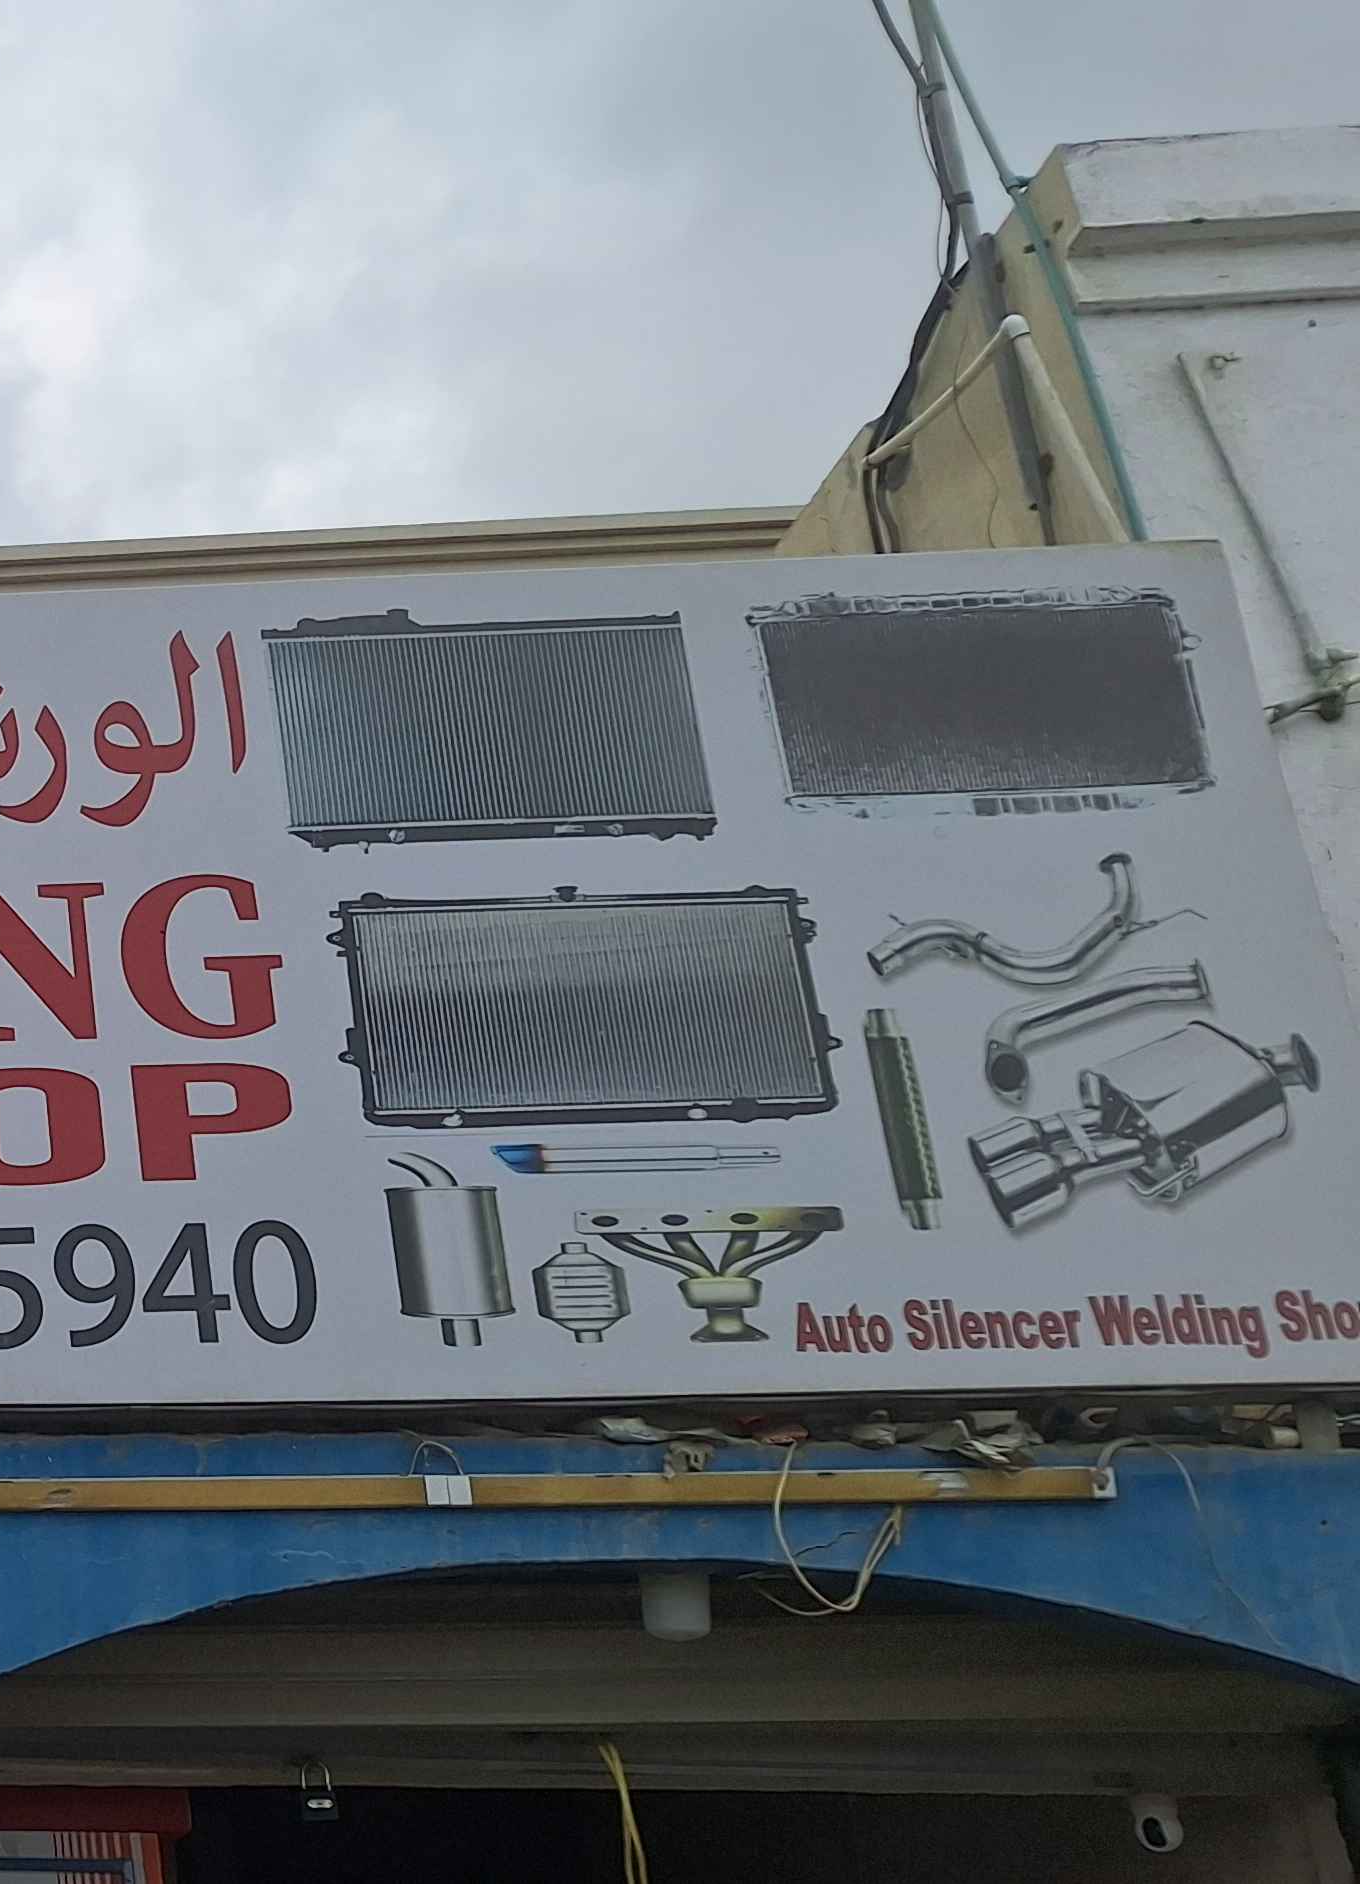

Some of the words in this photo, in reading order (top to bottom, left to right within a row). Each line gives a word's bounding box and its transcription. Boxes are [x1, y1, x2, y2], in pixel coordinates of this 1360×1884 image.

[796, 1301, 894, 1353] Auto
[902, 1298, 1081, 1350] Silencer
[1087, 1293, 1270, 1359] Welding
[1274, 1289, 1360, 1342] Sho
